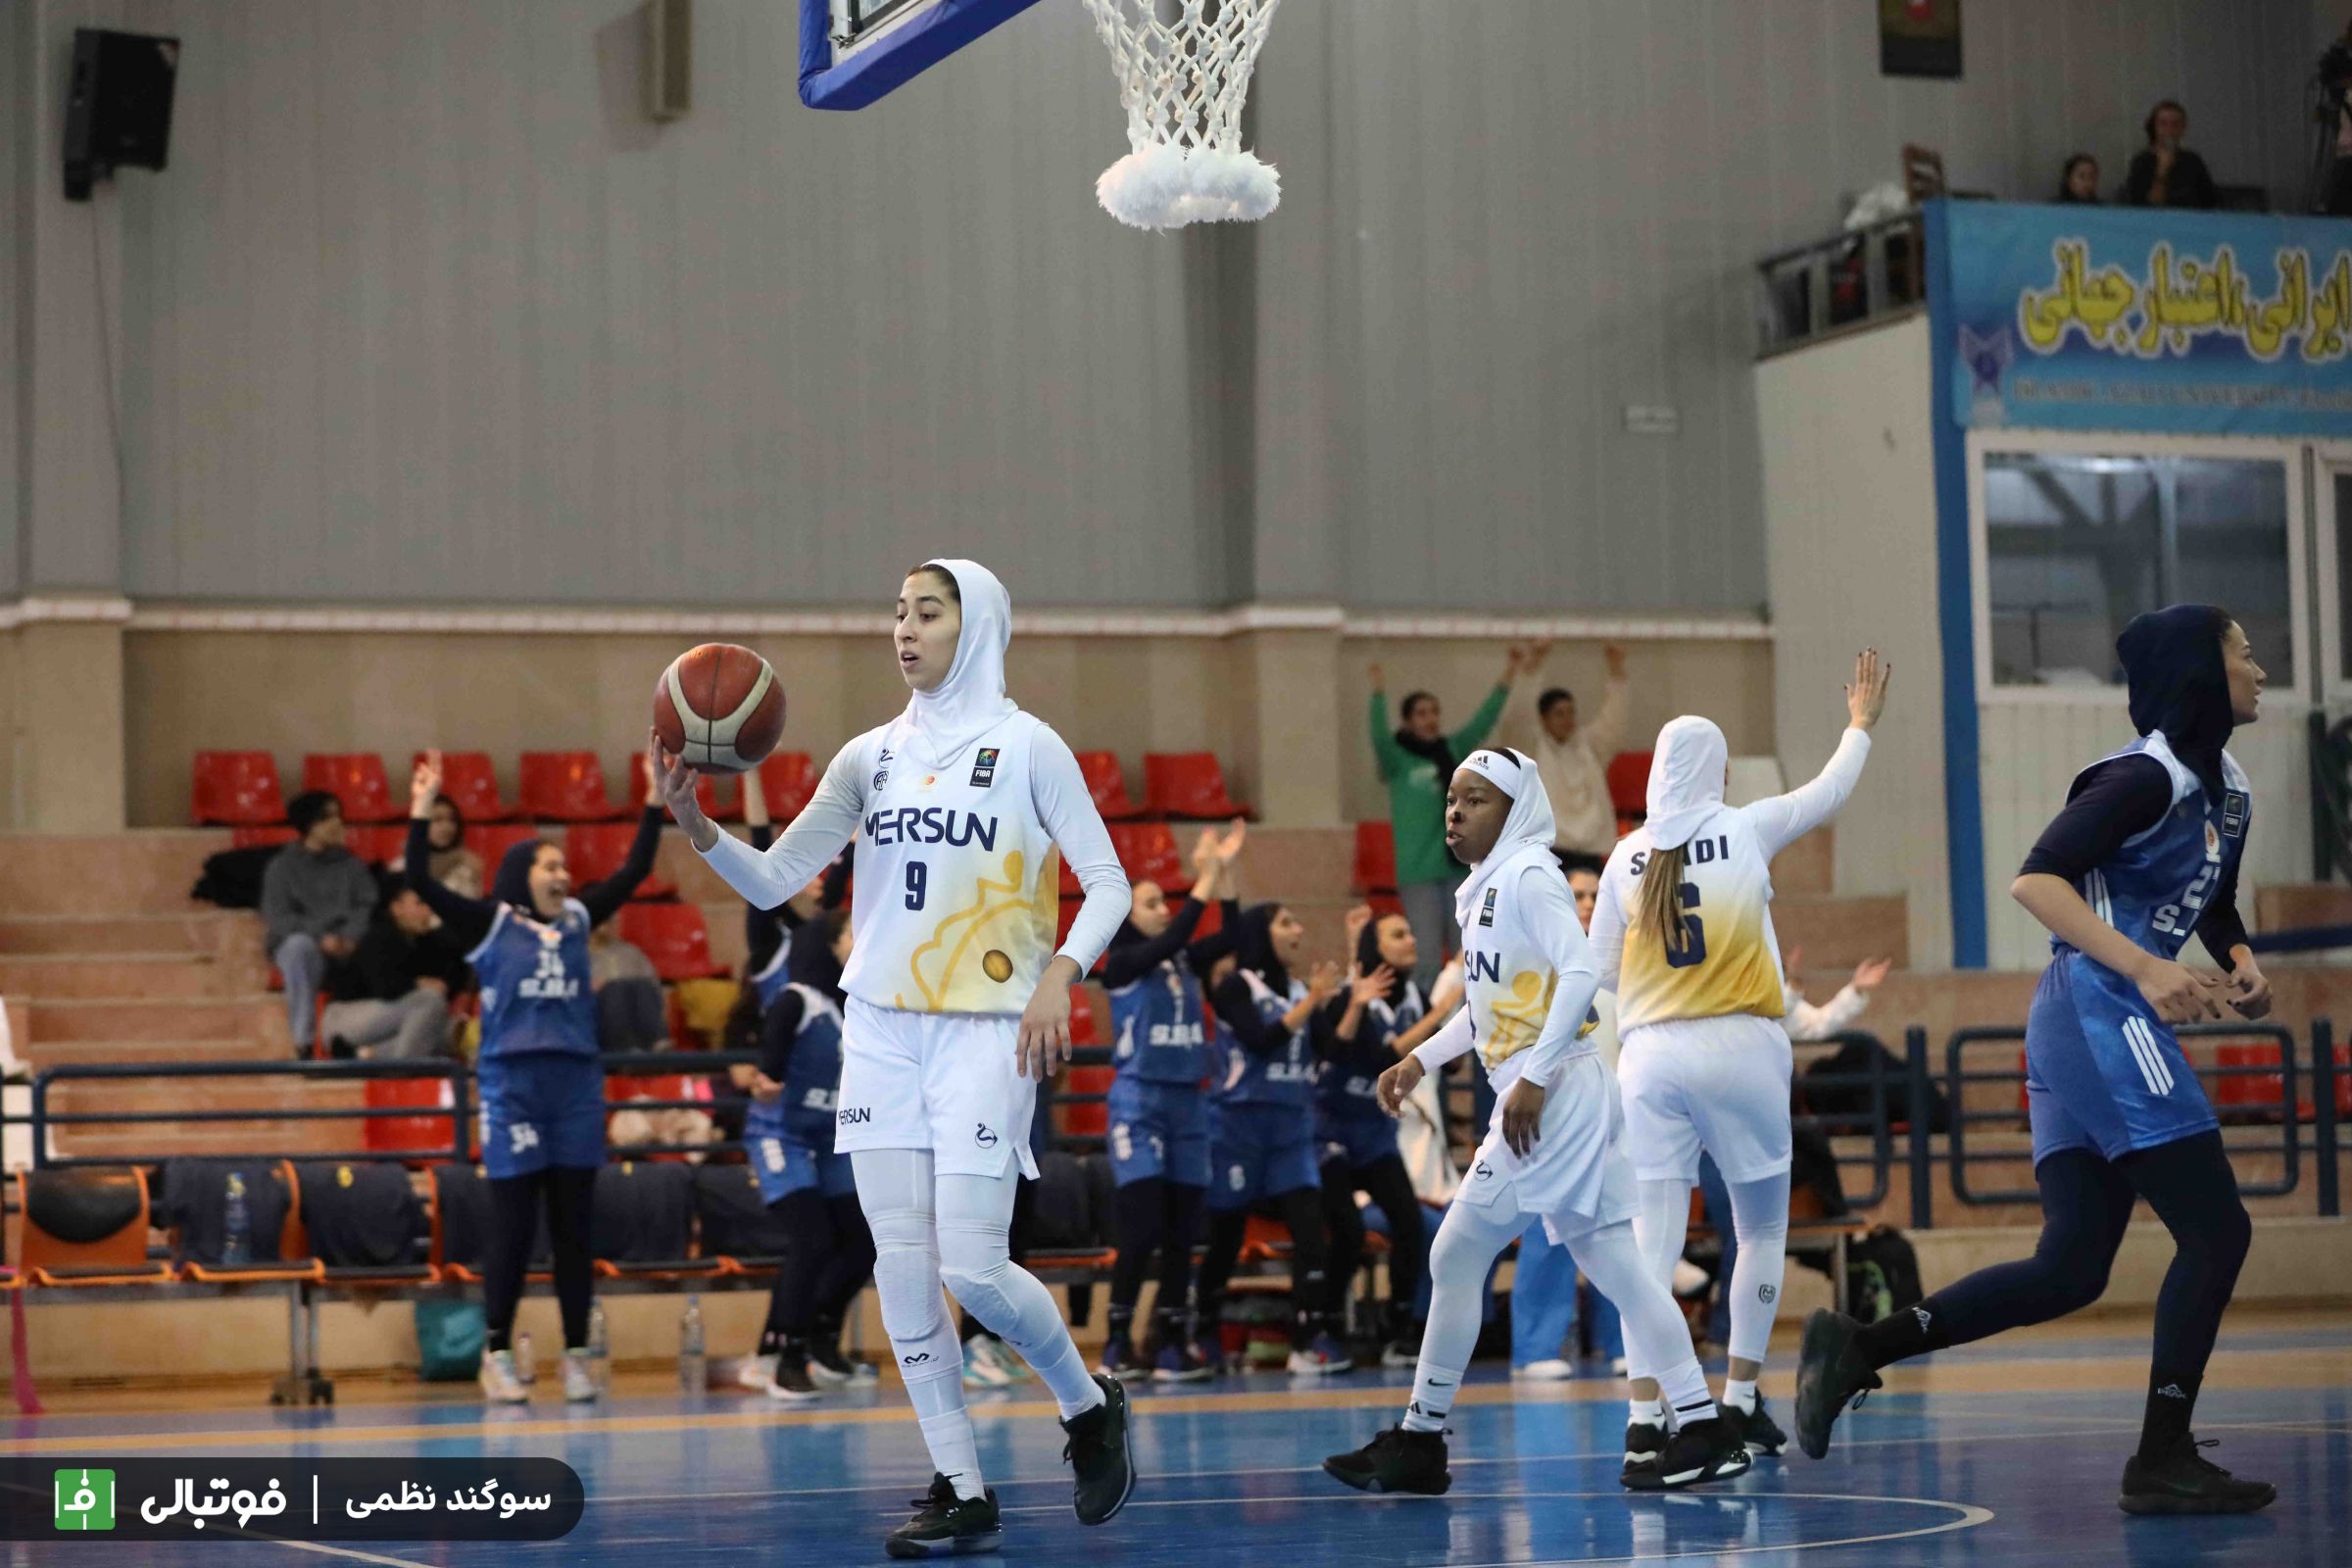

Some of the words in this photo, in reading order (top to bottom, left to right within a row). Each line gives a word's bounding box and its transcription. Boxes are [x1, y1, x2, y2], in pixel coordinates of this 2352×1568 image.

[975, 769, 992, 778] FIBA
[864, 807, 999, 853] MERSUN
[1630, 834, 1730, 876] SDI
[905, 860, 928, 911] 9
[1665, 881, 1707, 969] 6
